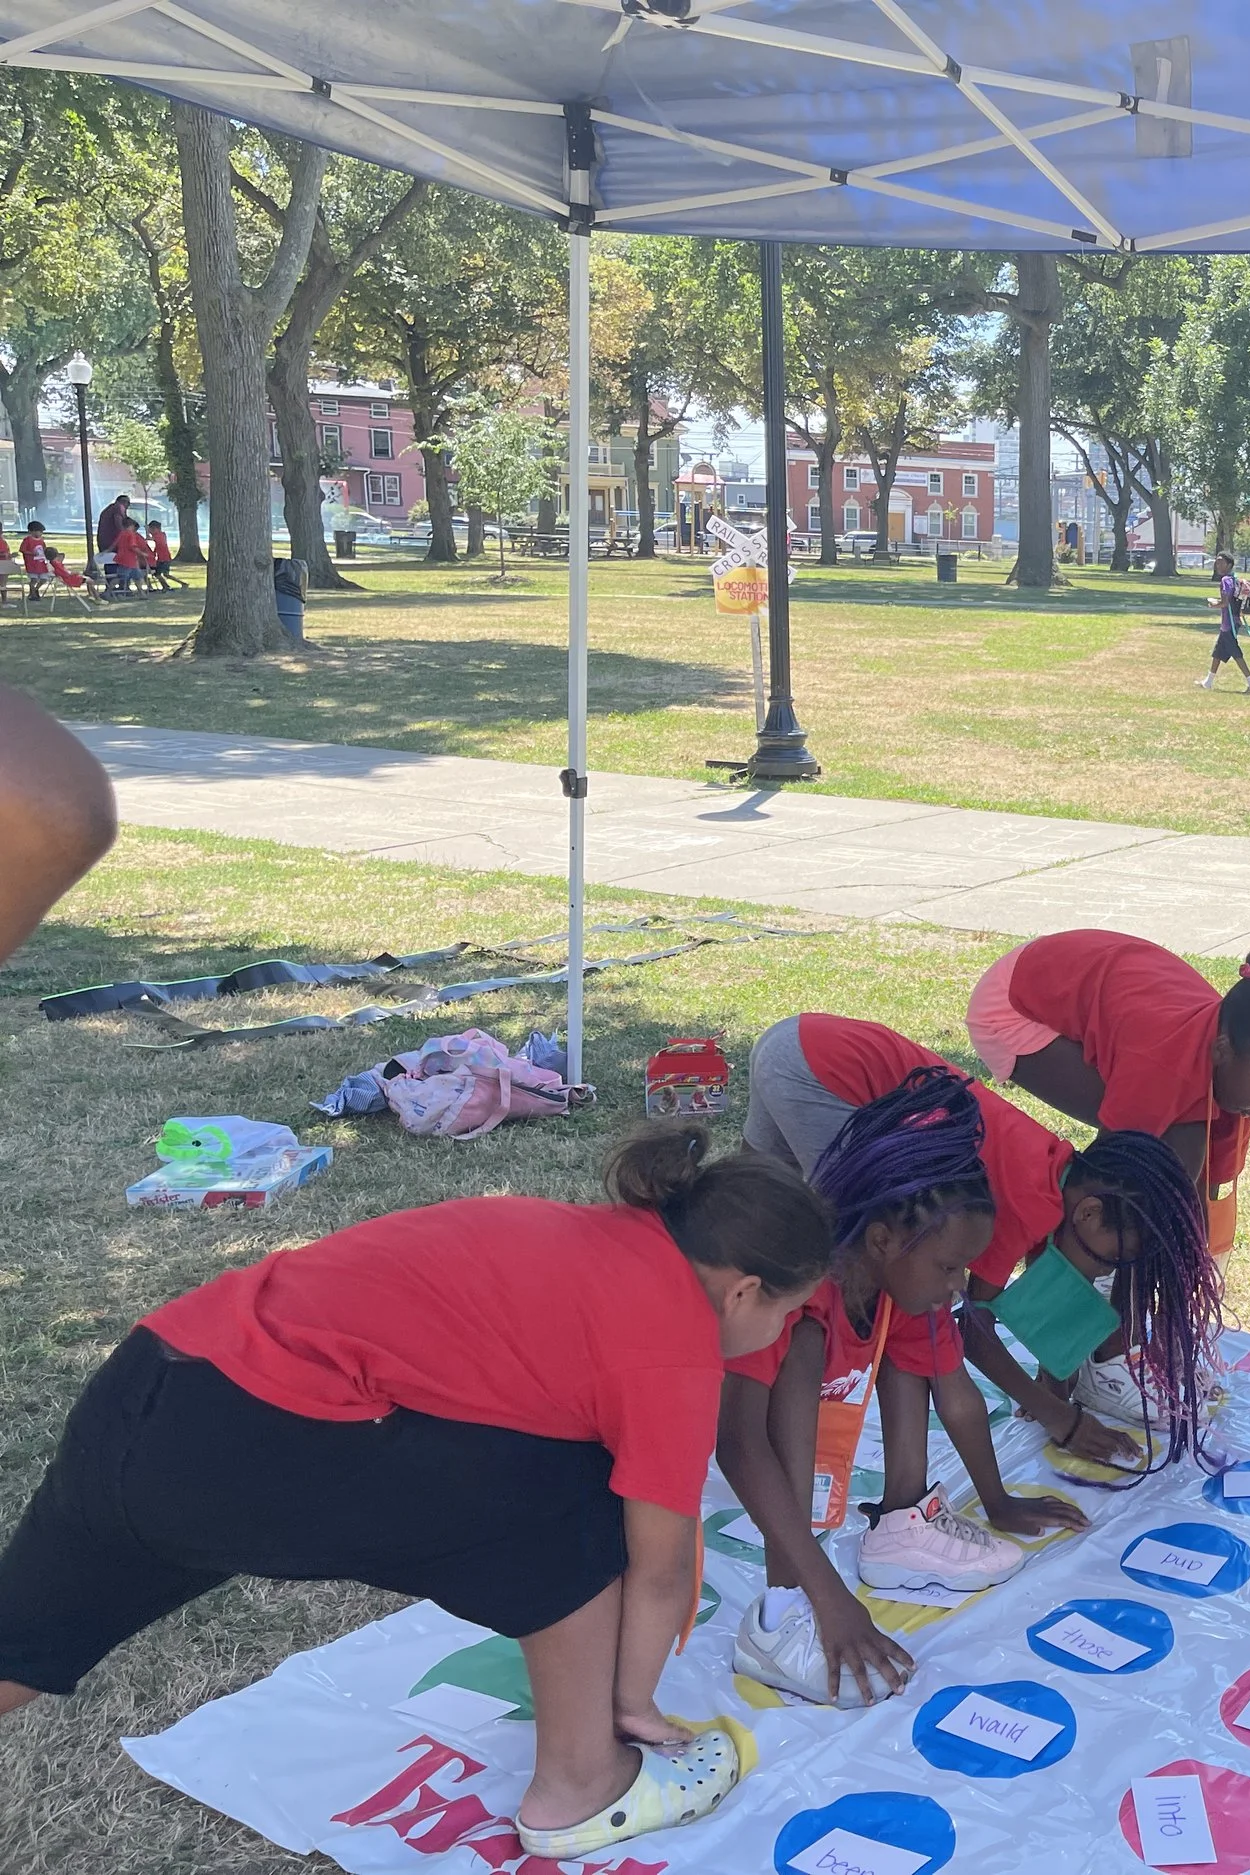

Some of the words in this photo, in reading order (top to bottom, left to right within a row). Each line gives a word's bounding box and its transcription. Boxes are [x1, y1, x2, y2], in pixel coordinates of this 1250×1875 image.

[711, 521, 738, 545] RAIL
[713, 534, 767, 577] CROSSI
[717, 582, 767, 592] LOCOMOTI
[1160, 1552, 1203, 1571] and
[1062, 1628, 1113, 1659] those
[1155, 1795, 1187, 1837] into
